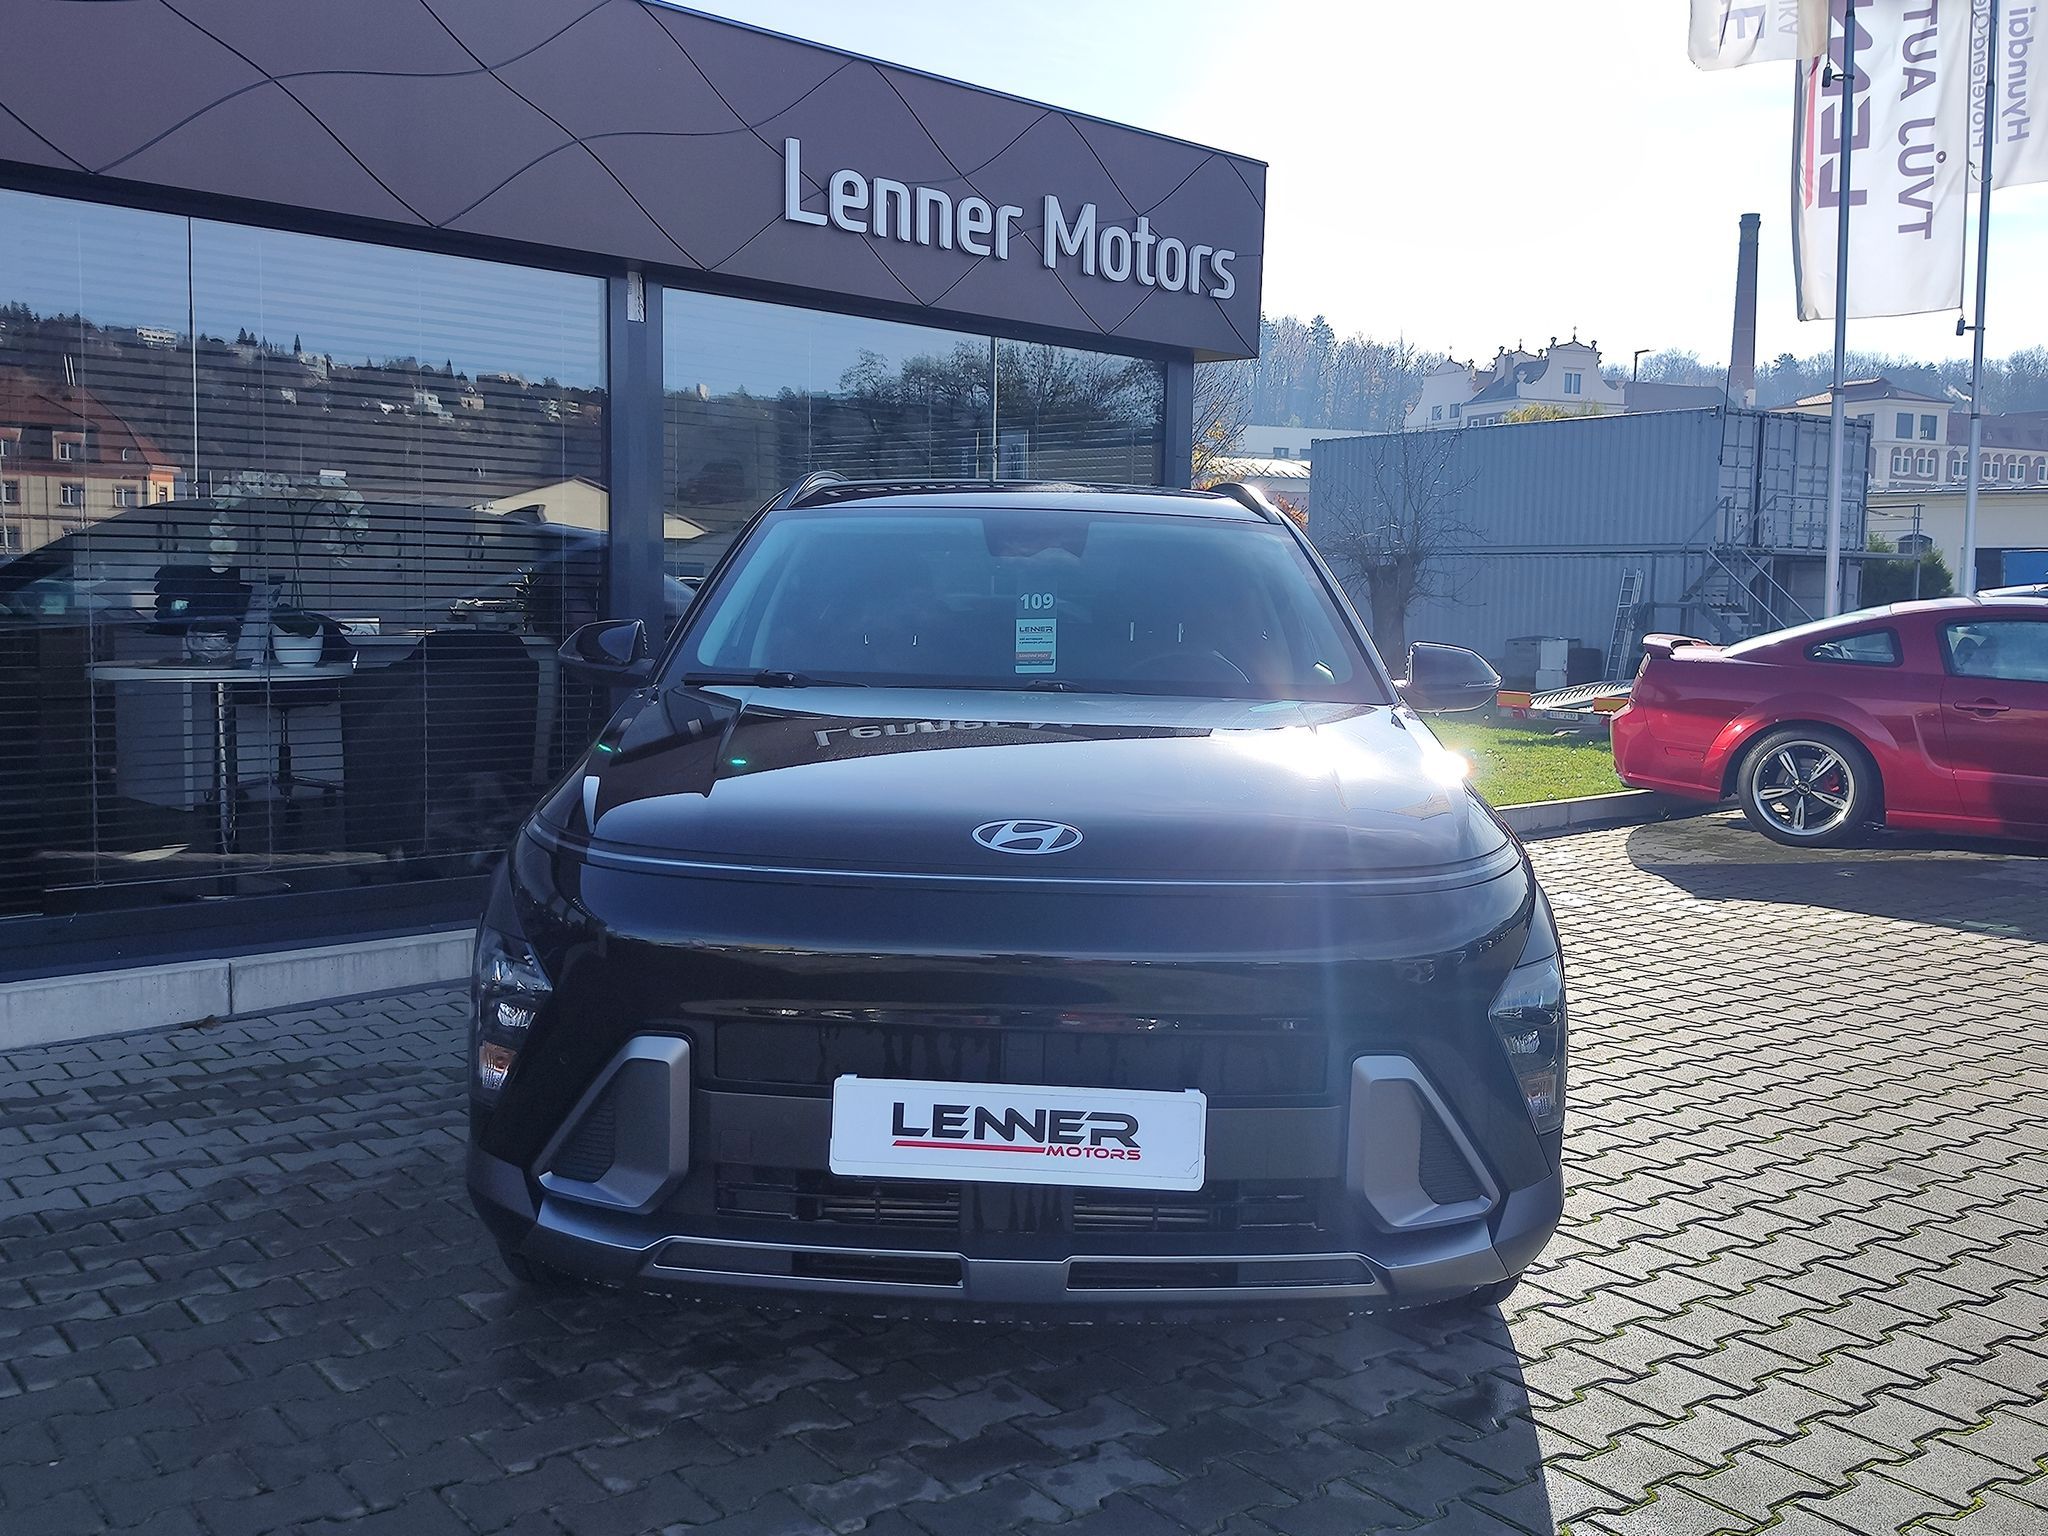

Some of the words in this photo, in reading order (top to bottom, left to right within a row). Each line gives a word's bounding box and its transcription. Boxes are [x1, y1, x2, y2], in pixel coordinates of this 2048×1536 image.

[784, 137, 1024, 260] Lenner
[1043, 194, 1237, 300] Motors
[1020, 593, 1054, 610] 109
[892, 1101, 1142, 1149] LENNER
[1046, 1145, 1142, 1161] MOTORS
